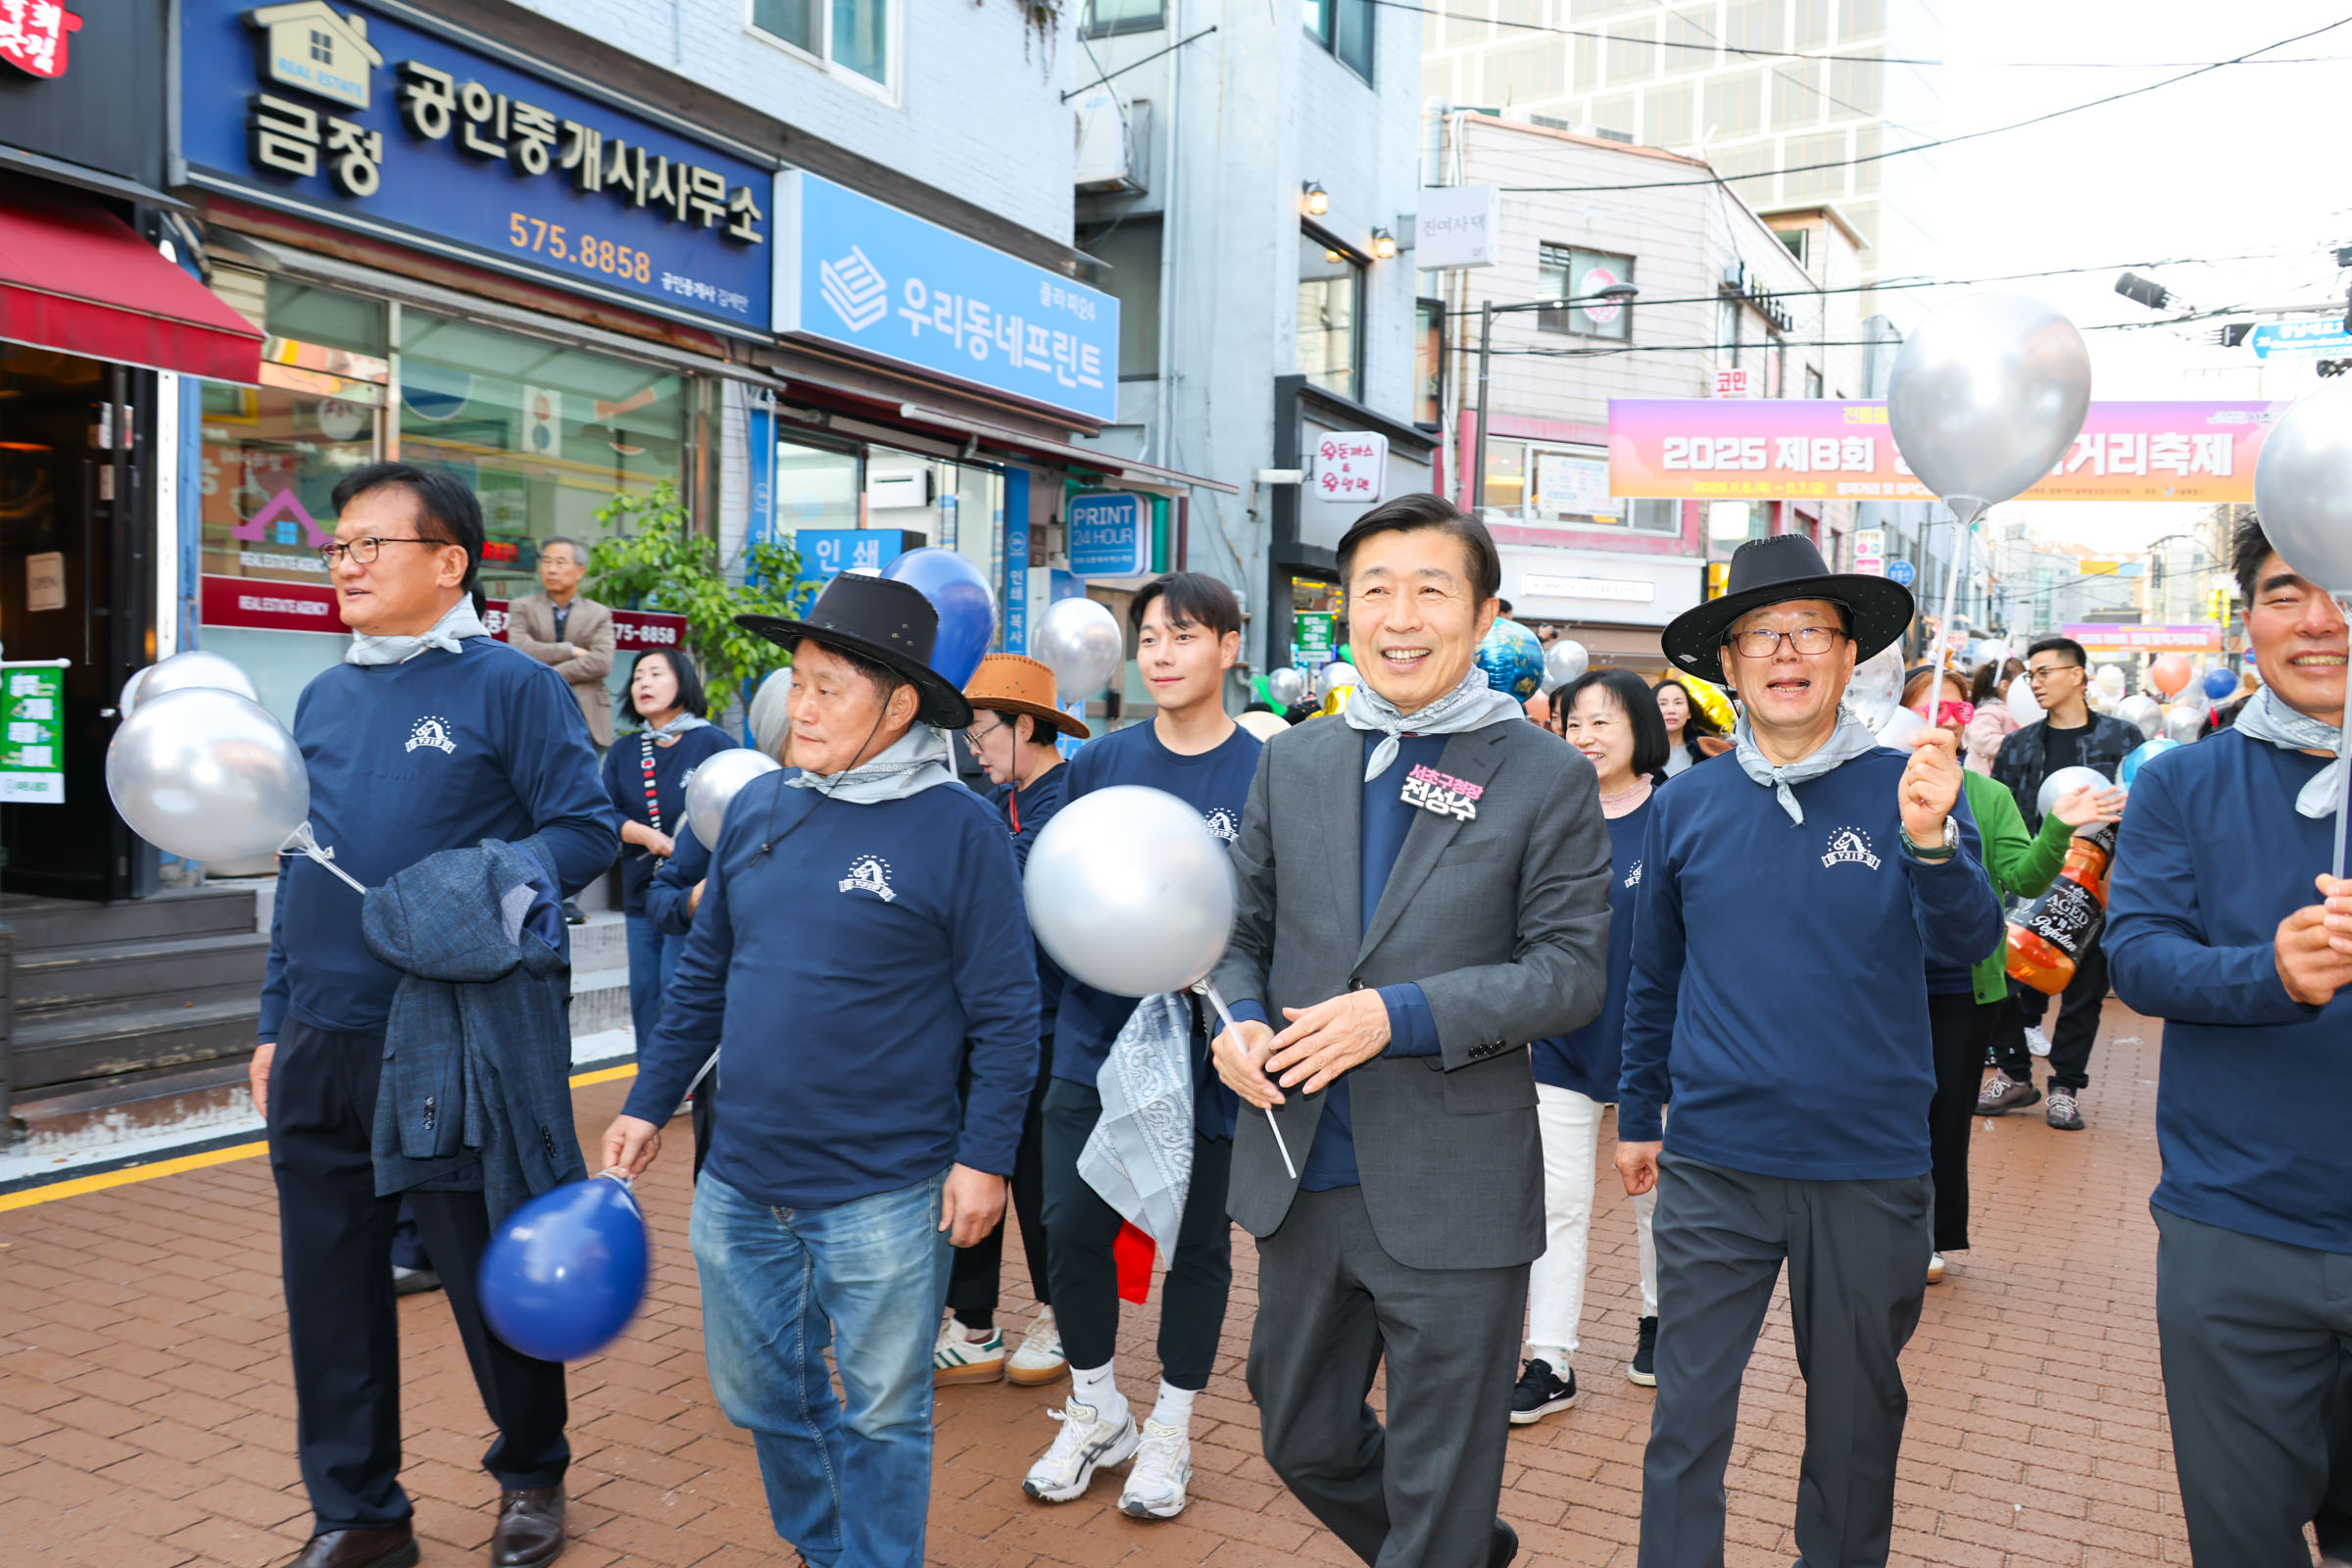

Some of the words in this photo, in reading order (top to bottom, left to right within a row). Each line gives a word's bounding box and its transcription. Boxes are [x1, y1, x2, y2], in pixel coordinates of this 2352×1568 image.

[277, 57, 313, 81] REAL
[316, 71, 364, 100] ESTATE
[258, 93, 383, 197] 금정
[405, 60, 763, 244] 공인중개사사무소
[509, 212, 651, 284] 575.8858
[898, 277, 1104, 389] 우리동네프린트
[1717, 370, 1747, 392] 코인
[1663, 436, 1766, 471] 2025
[1775, 436, 1875, 473] 제8회
[2051, 432, 2233, 476] 거리축제
[1073, 505, 1134, 526] PRINT
[815, 538, 880, 573] 인쇄
[1073, 530, 1091, 546] 24
[1093, 528, 1134, 545] HOUR
[238, 594, 264, 610] REAL
[264, 596, 297, 612] ESTATE
[297, 599, 329, 615] AGENCY
[1399, 775, 1477, 821] 전성수
[1408, 762, 1485, 801] 서초구청장
[2045, 893, 2089, 925] AGED
[2029, 915, 2078, 952] Perfection
